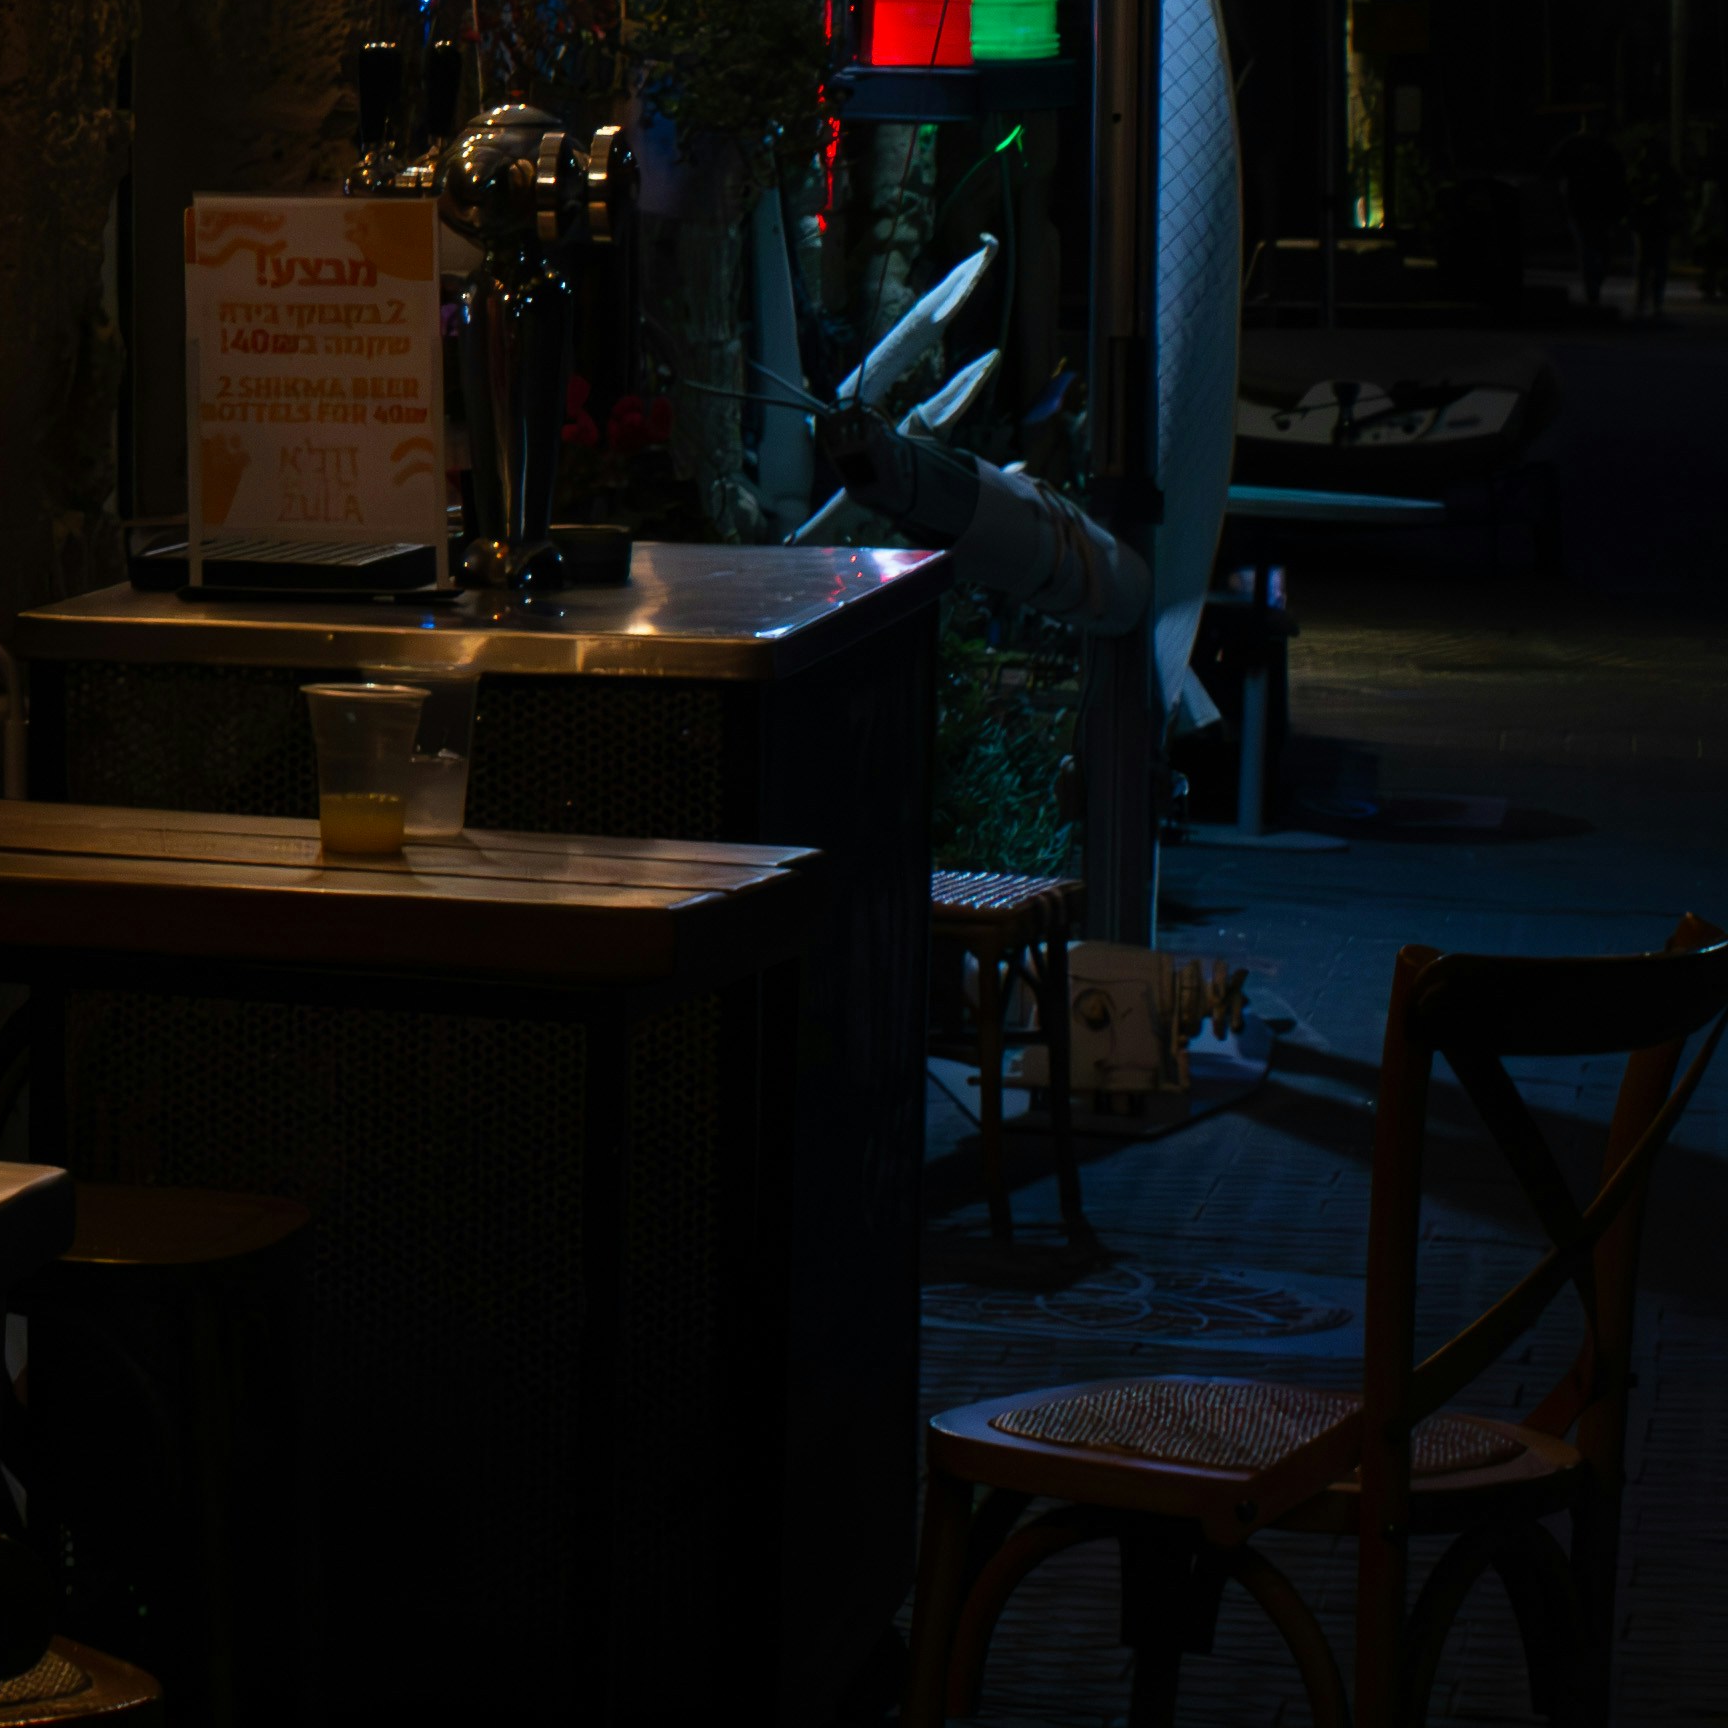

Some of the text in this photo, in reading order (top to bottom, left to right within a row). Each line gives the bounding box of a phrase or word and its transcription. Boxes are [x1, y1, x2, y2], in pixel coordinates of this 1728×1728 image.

[256, 251, 378, 288] מבצע!
[387, 299, 408, 324] 2
[216, 375, 419, 399] 2 SHIKMA BEER
[317, 402, 367, 424] FOR
